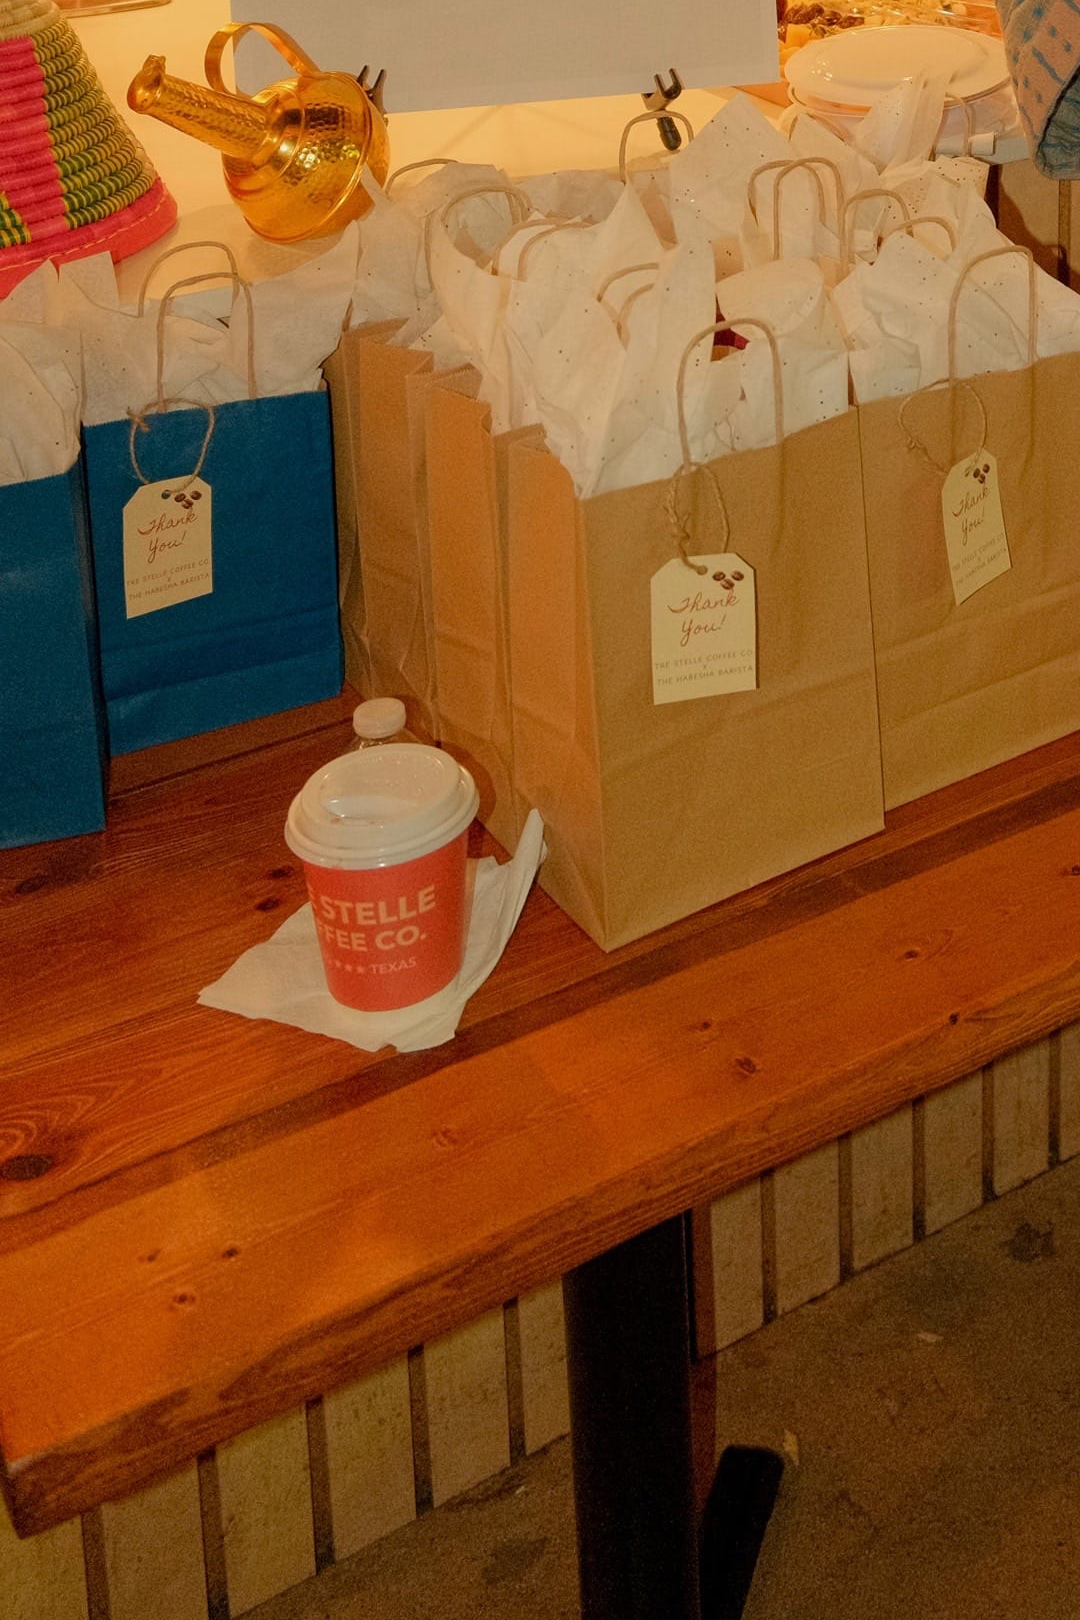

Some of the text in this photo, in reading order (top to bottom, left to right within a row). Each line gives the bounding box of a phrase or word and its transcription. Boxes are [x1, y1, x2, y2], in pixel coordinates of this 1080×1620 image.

[951, 484, 991, 517] Thank
[137, 507, 198, 536] Thank
[961, 507, 985, 547] You!
[147, 531, 188, 564] You!
[667, 588, 742, 613] Thank
[680, 614, 727, 647] You!
[320, 884, 437, 925] STELLE
[374, 925, 427, 951] CO.
[369, 956, 418, 975] TEXAS
